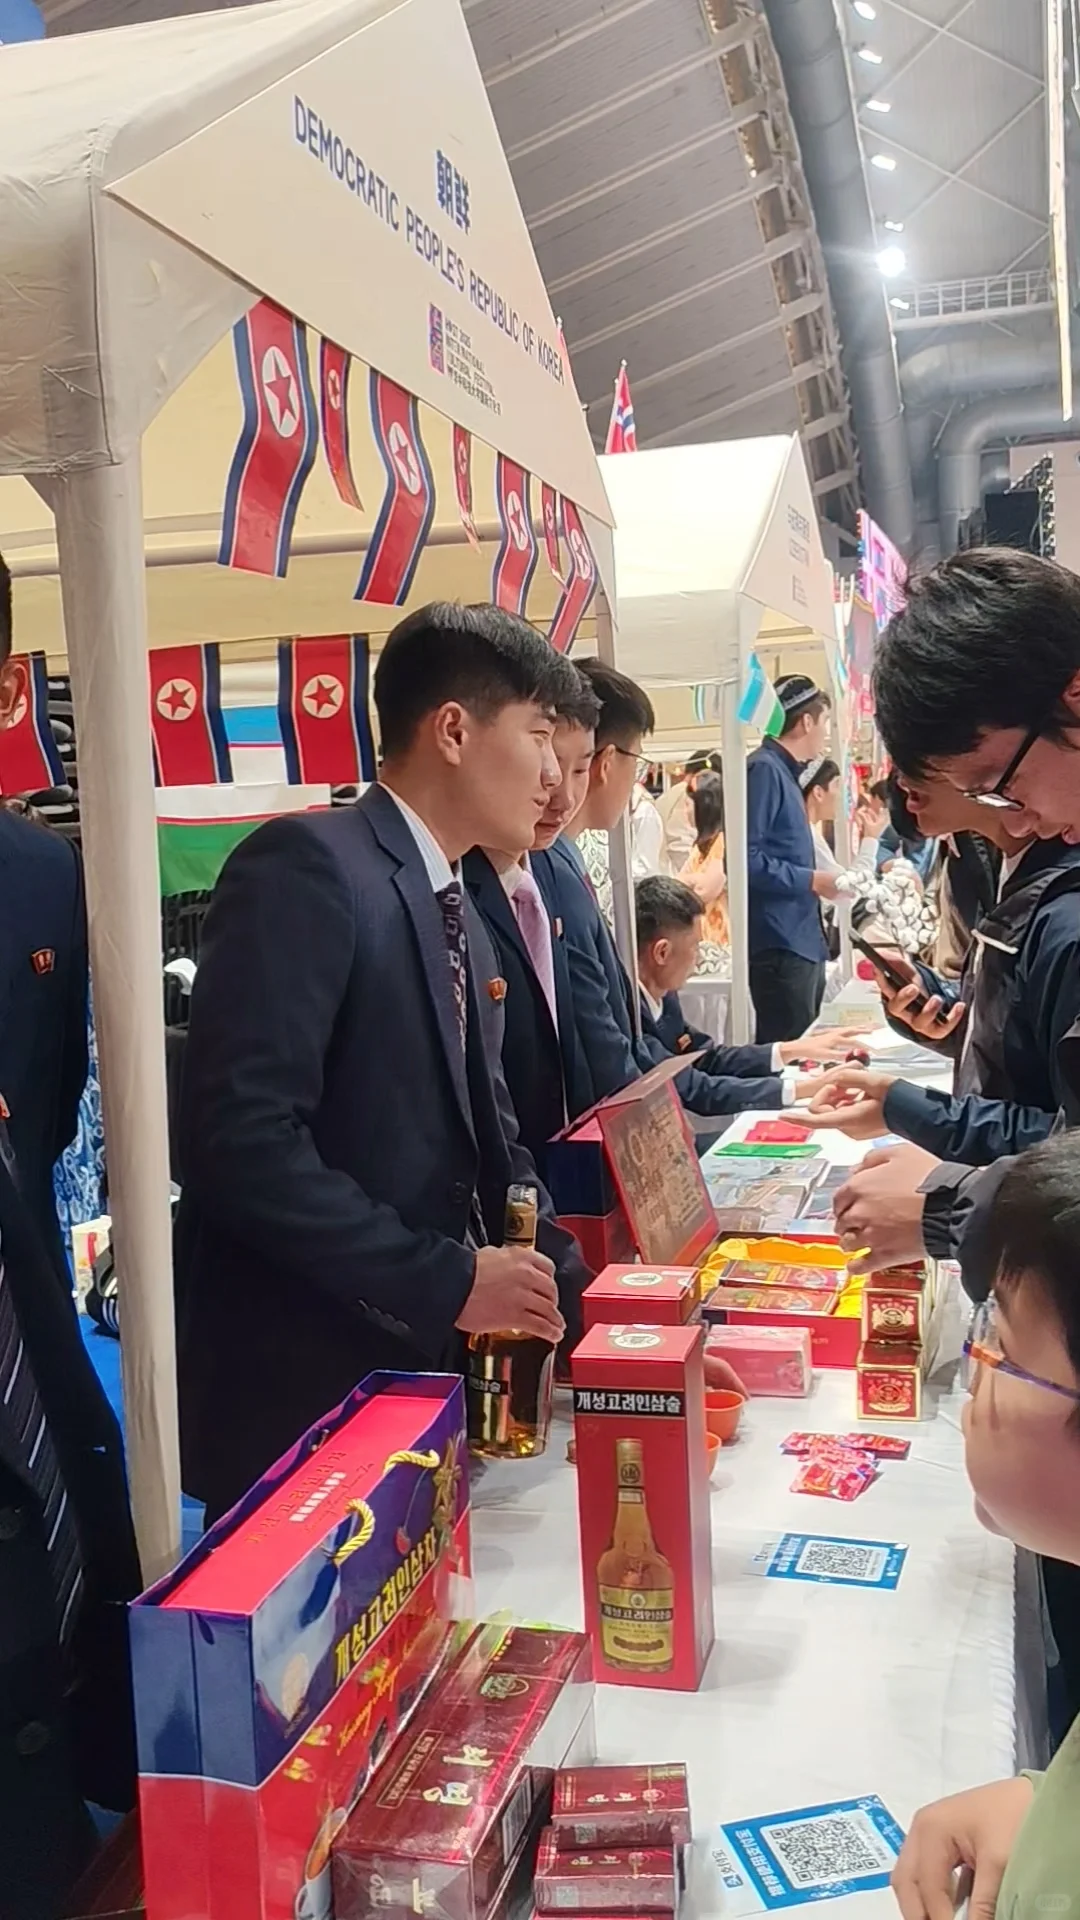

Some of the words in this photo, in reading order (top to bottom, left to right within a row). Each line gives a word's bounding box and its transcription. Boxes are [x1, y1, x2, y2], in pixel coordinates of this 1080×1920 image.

[294, 94, 399, 232] DEMOCRATIC
[405, 205, 465, 293] PEOPLE'S
[469, 268, 519, 343] REPUBLIC
[522, 321, 535, 356] OF
[537, 335, 565, 386] KOREA
[436, 149, 471, 236] 朝鲜
[576, 1391, 681, 1413] 개성고려인삼술
[334, 1526, 437, 1688] 개성고려인삼차
